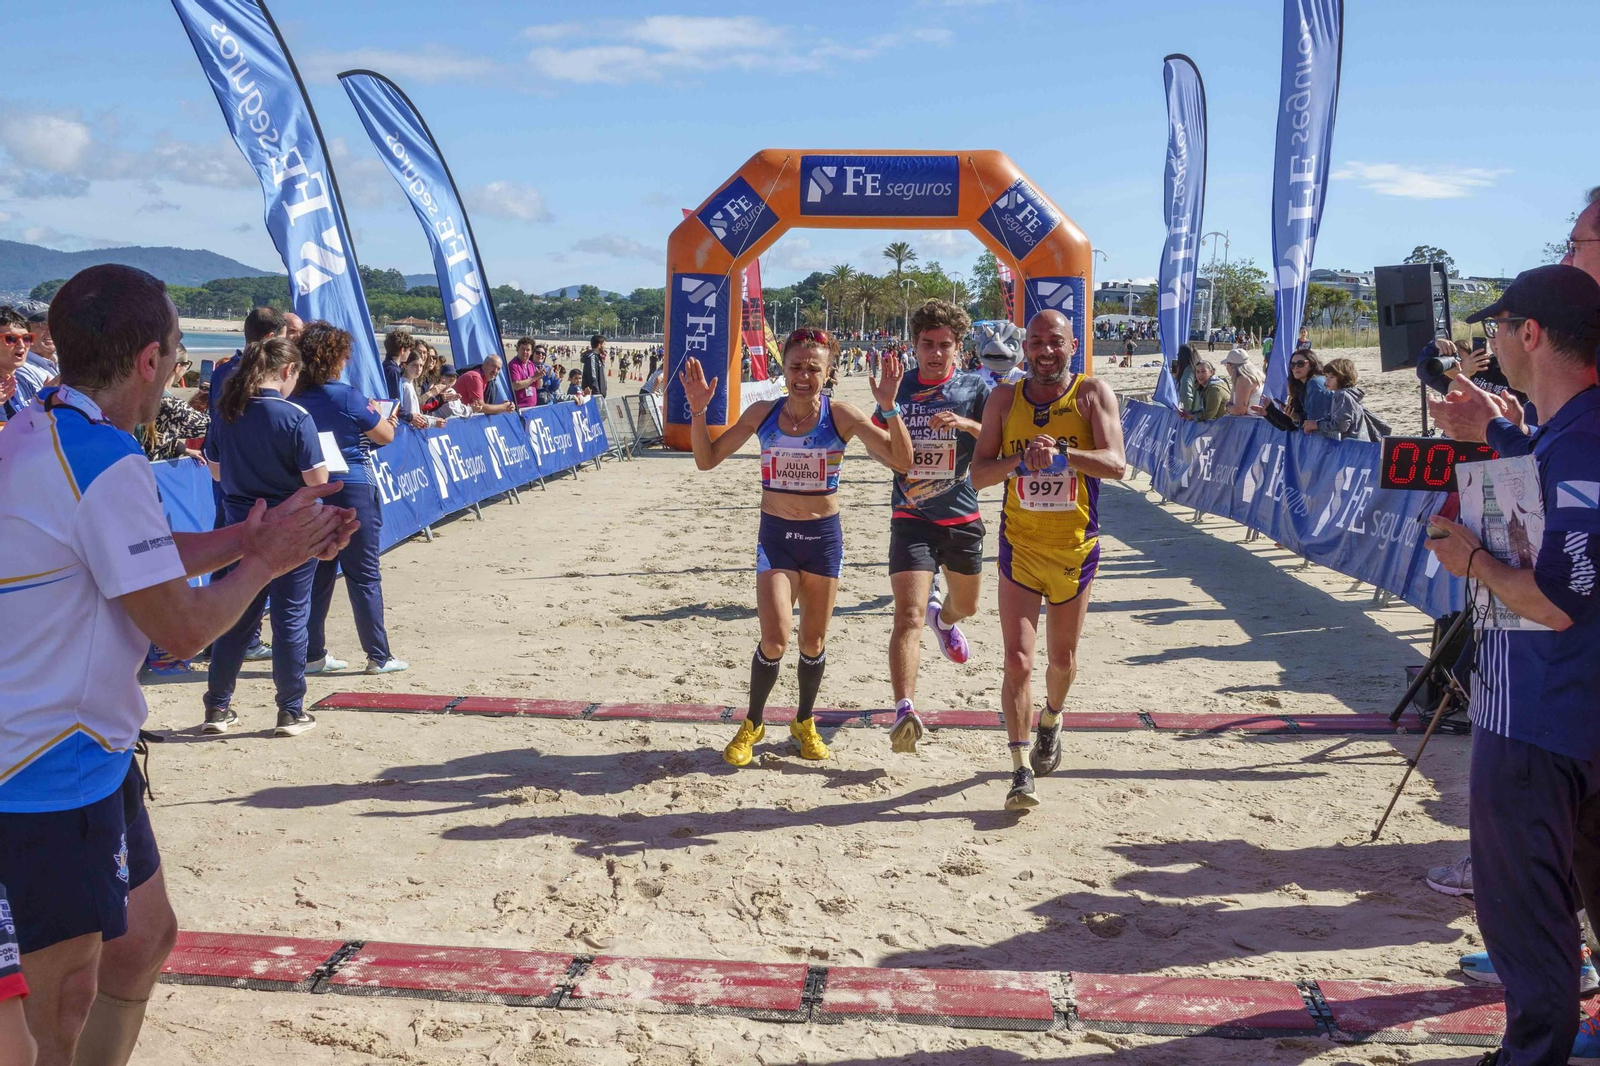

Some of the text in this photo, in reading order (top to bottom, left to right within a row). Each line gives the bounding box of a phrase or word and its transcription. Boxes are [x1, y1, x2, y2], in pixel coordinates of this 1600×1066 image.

[842, 166, 953, 200] FE seguros
[722, 195, 753, 221] FE
[731, 201, 766, 236] seguros
[1015, 202, 1042, 233] FE
[1001, 213, 1037, 247] seguros
[685, 312, 716, 351] FE
[785, 462, 809, 471] JULIA
[913, 452, 944, 466] 687
[776, 470, 819, 479] VAQUERO
[1029, 481, 1064, 496] 997
